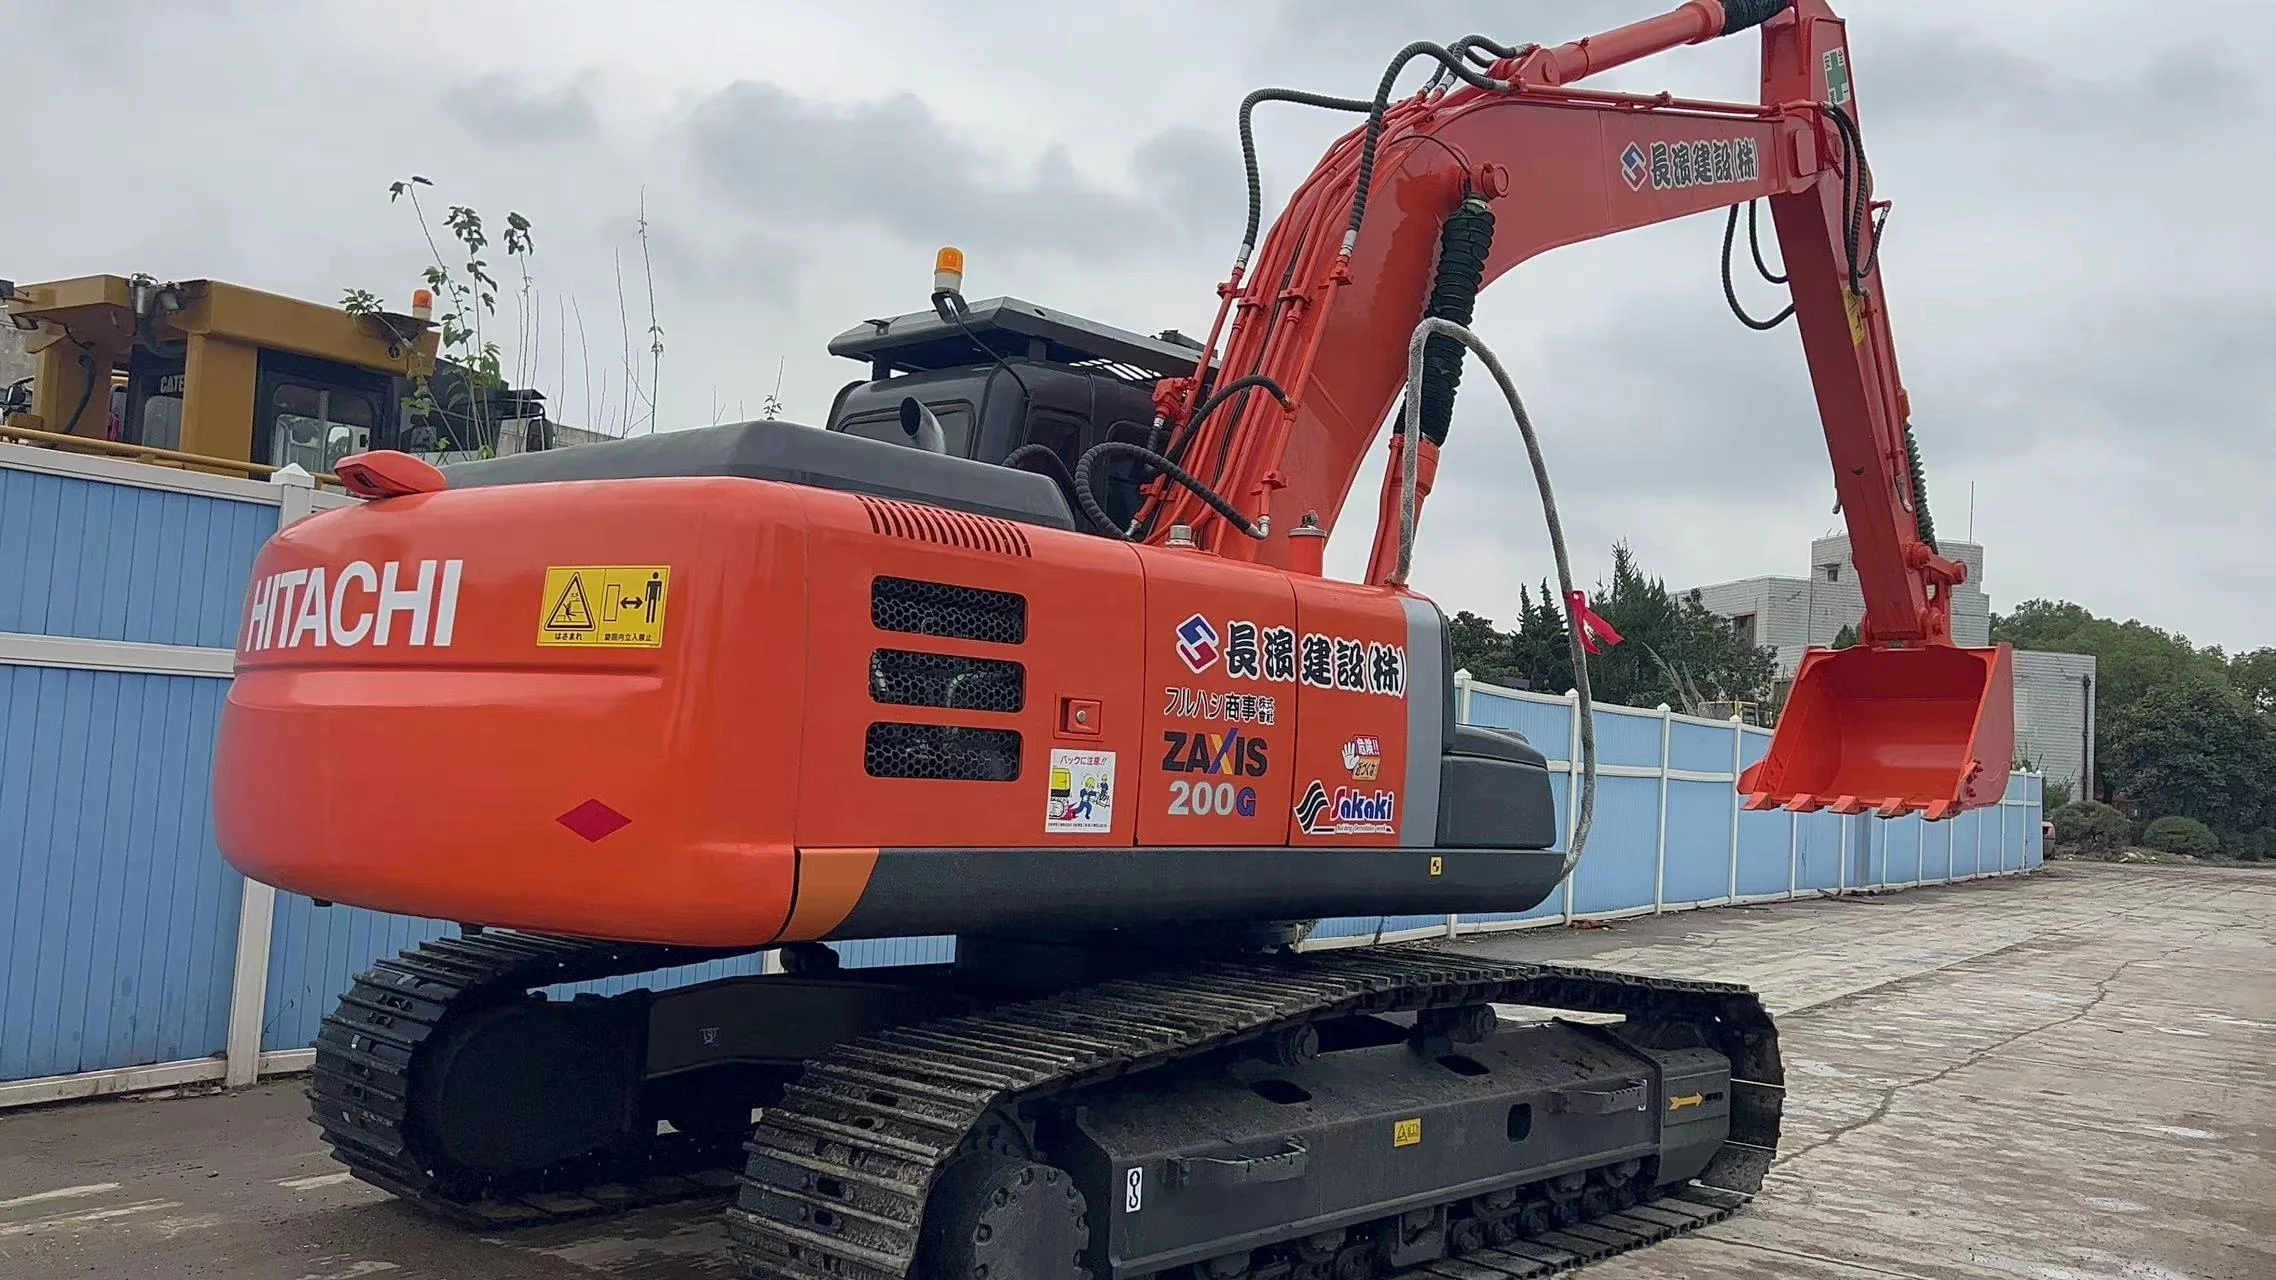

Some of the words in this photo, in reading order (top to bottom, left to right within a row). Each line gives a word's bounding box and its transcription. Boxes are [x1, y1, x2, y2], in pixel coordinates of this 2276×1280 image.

[245, 558, 464, 653] HITACHI
[554, 632, 583, 641] はさまれ
[1162, 728, 1268, 777] ZAXIS
[1168, 780, 1257, 817] 200G
[1331, 787, 1393, 820] Sakaki
